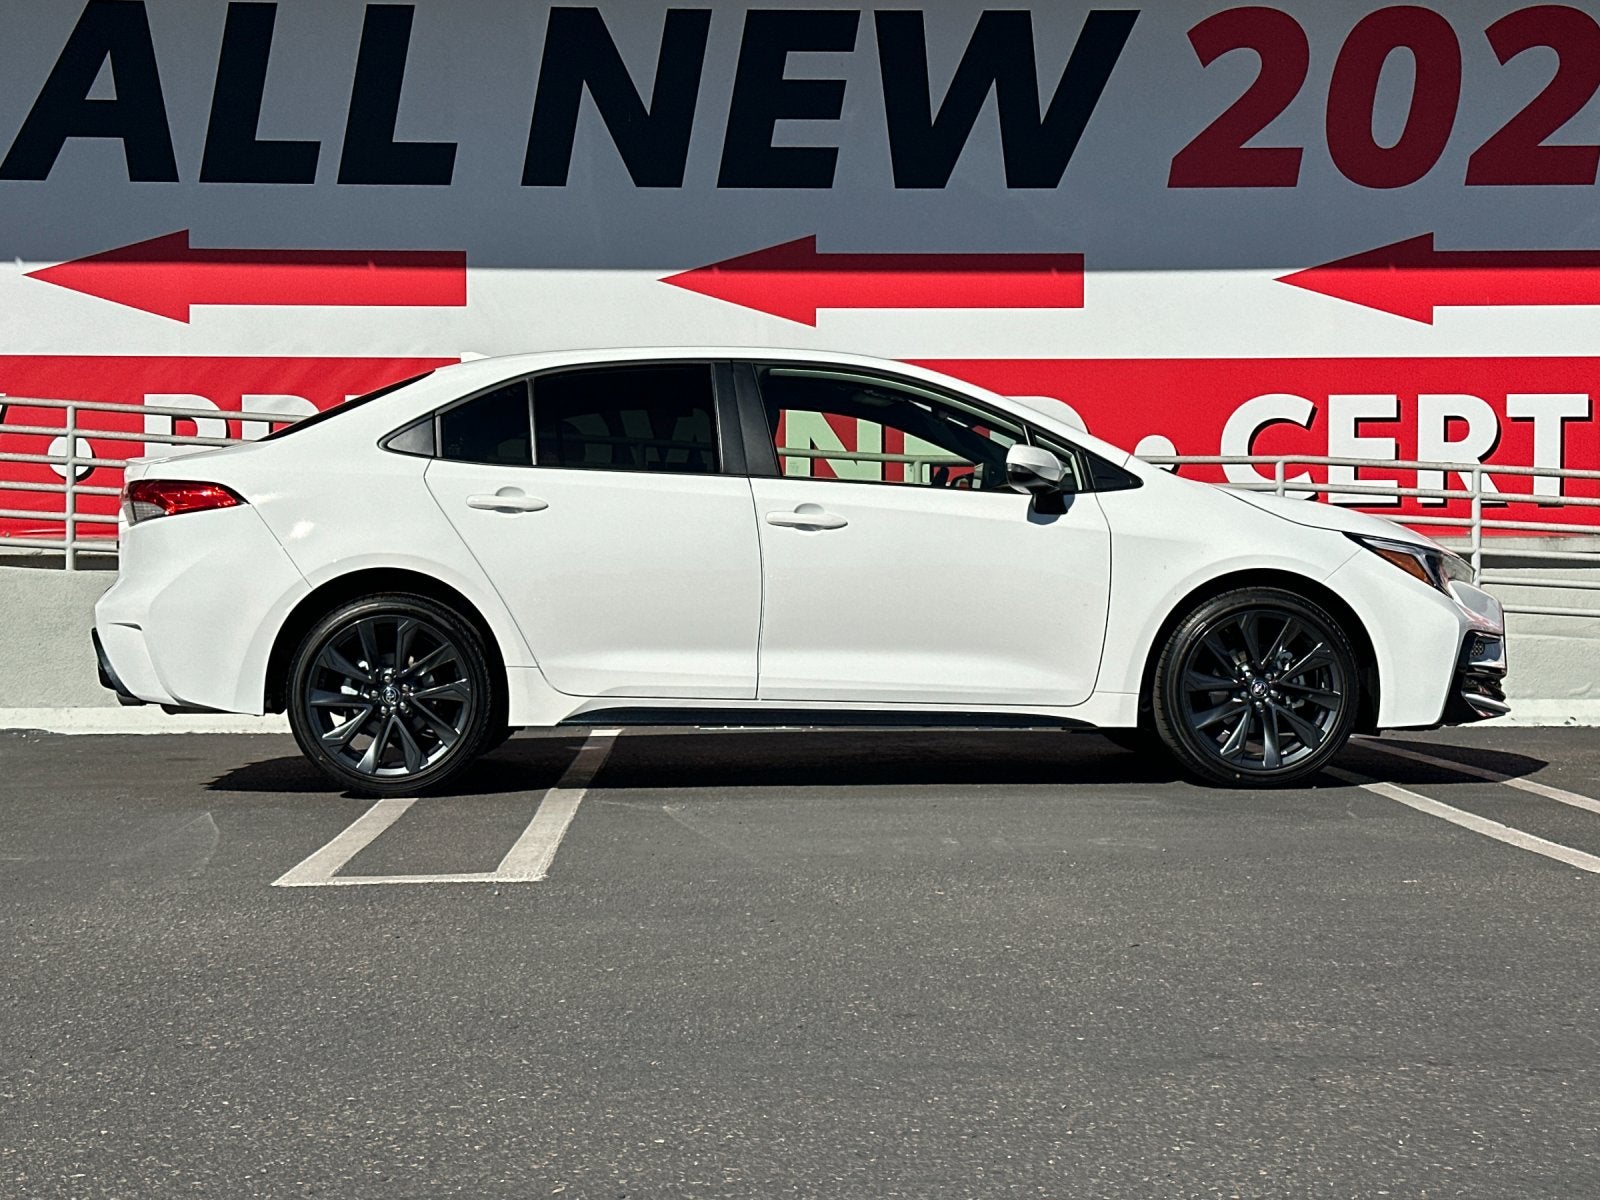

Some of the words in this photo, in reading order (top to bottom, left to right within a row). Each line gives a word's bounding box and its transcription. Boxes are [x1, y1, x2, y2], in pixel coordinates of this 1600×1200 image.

[0, 0, 457, 186] ALL
[521, 7, 1140, 189] NEW
[1167, 5, 1600, 189] 202
[1220, 393, 1593, 507] CERT
